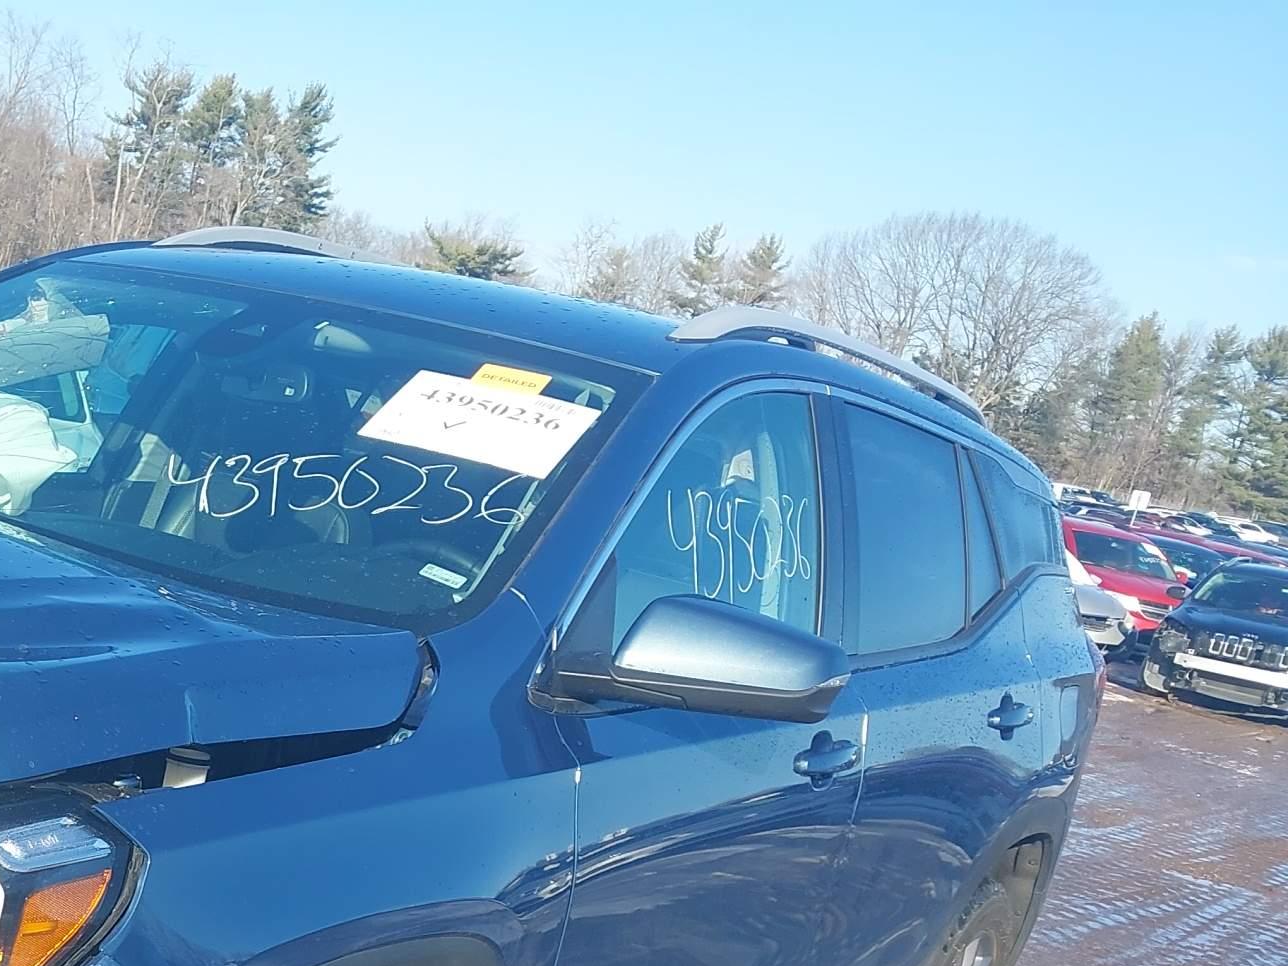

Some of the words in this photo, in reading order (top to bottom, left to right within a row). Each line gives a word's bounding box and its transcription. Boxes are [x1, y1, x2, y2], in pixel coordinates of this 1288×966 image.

[480, 372, 538, 389] DETAILED
[419, 389, 562, 432] 43950236
[167, 453, 527, 525] 43950236
[667, 488, 811, 605] 43950236
